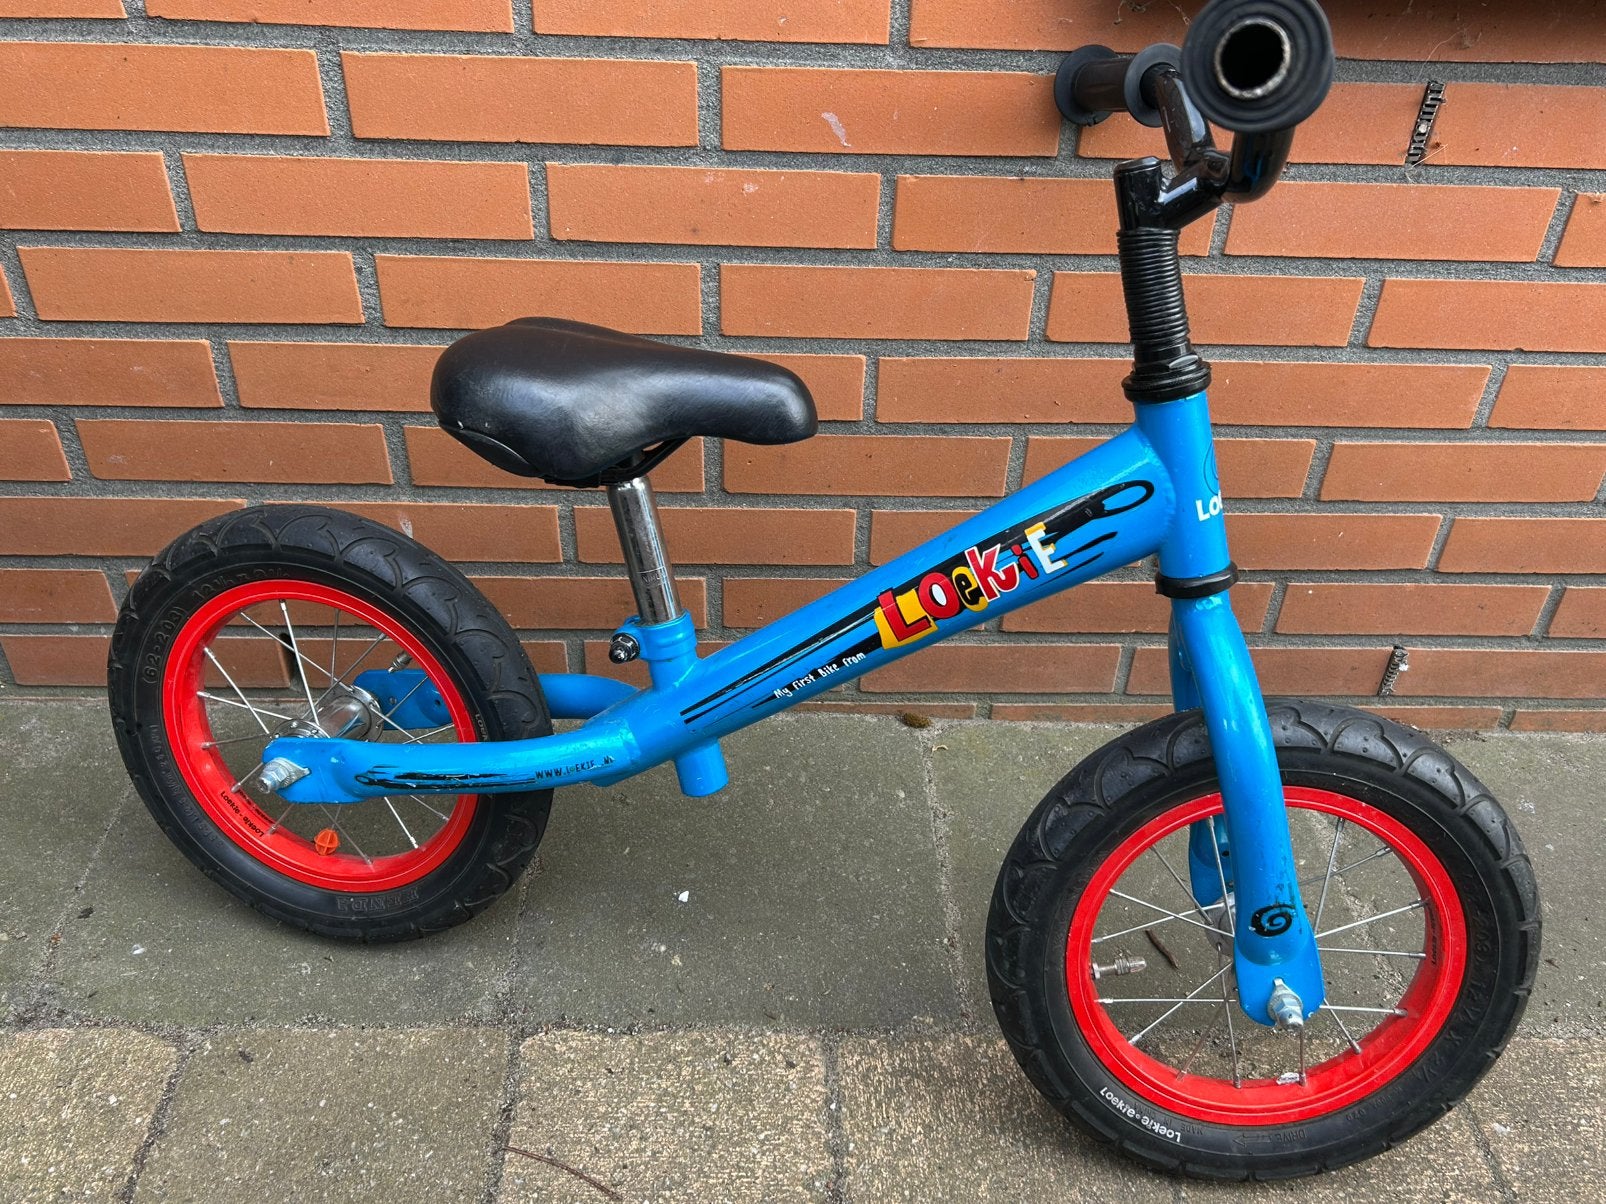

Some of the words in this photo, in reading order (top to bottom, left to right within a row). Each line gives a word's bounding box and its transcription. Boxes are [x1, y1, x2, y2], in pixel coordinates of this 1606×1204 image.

[773, 688, 793, 698] My
[792, 673, 816, 690] First
[817, 663, 840, 678] Bike
[842, 651, 867, 668] from
